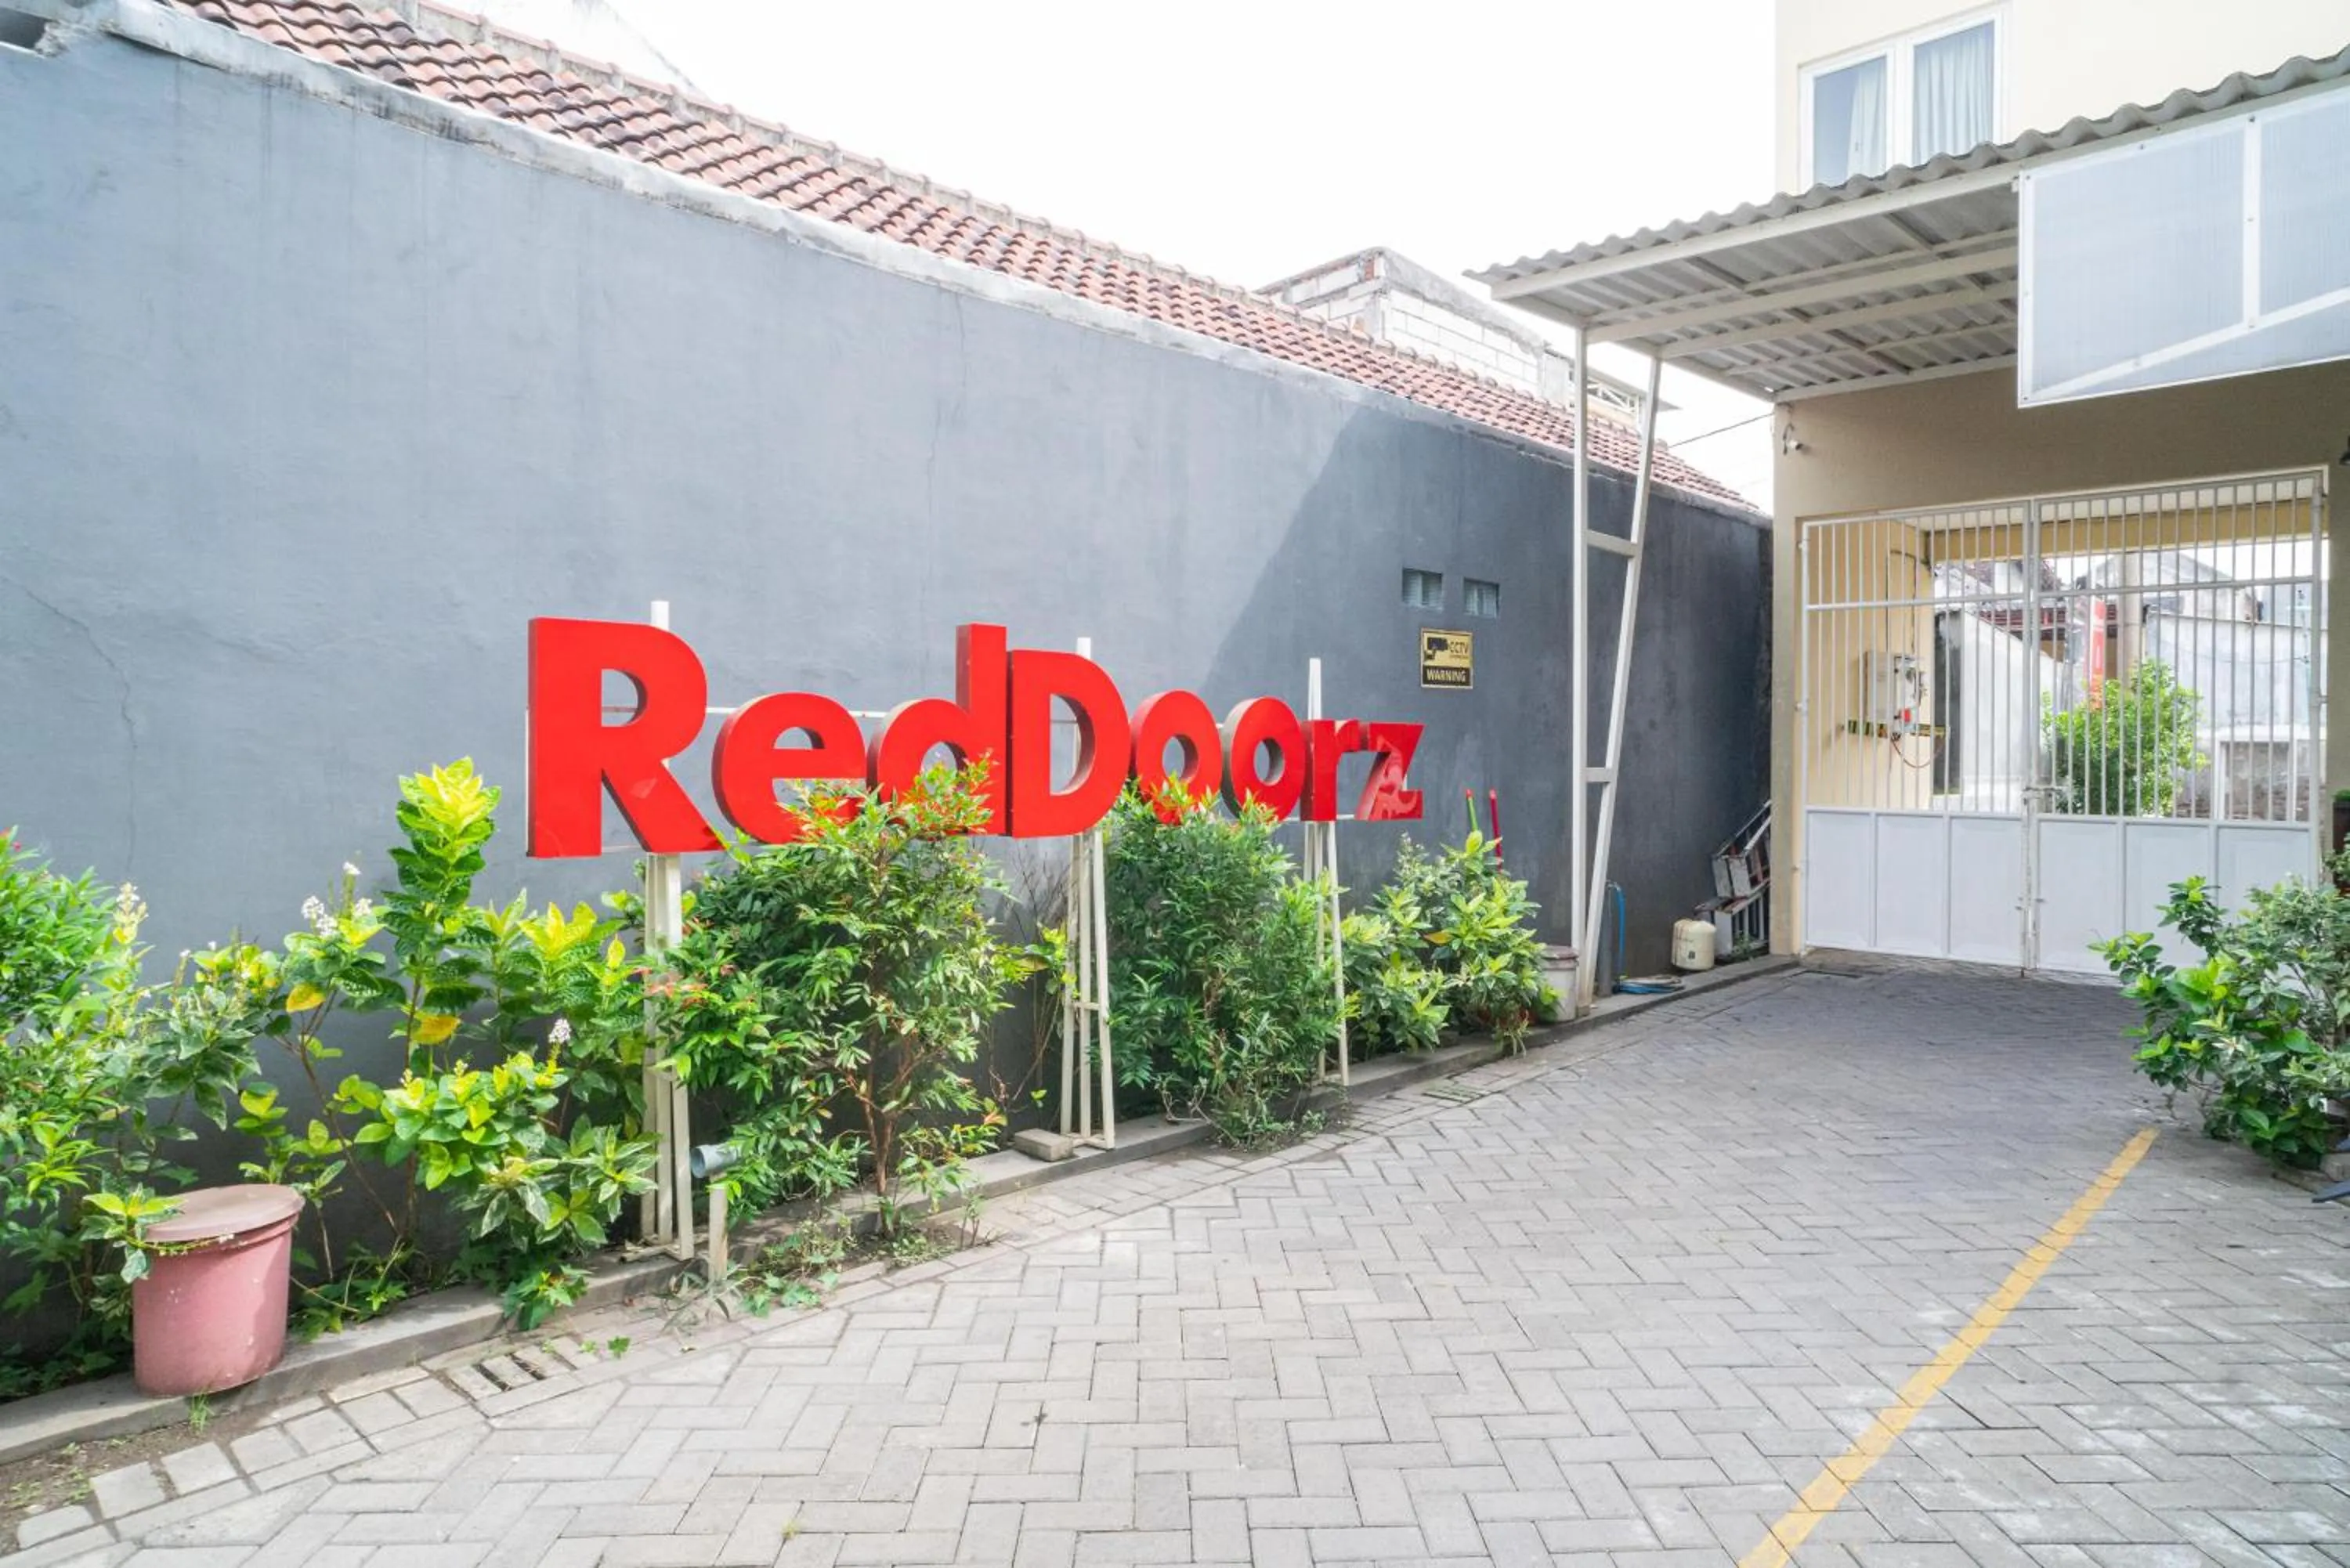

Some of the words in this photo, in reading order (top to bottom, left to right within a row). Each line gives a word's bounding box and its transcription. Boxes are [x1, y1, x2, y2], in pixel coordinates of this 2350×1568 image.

[1450, 641, 1470, 654] CCTV
[1427, 669, 1466, 682] WARNING
[528, 617, 1425, 858] RedDoorz
